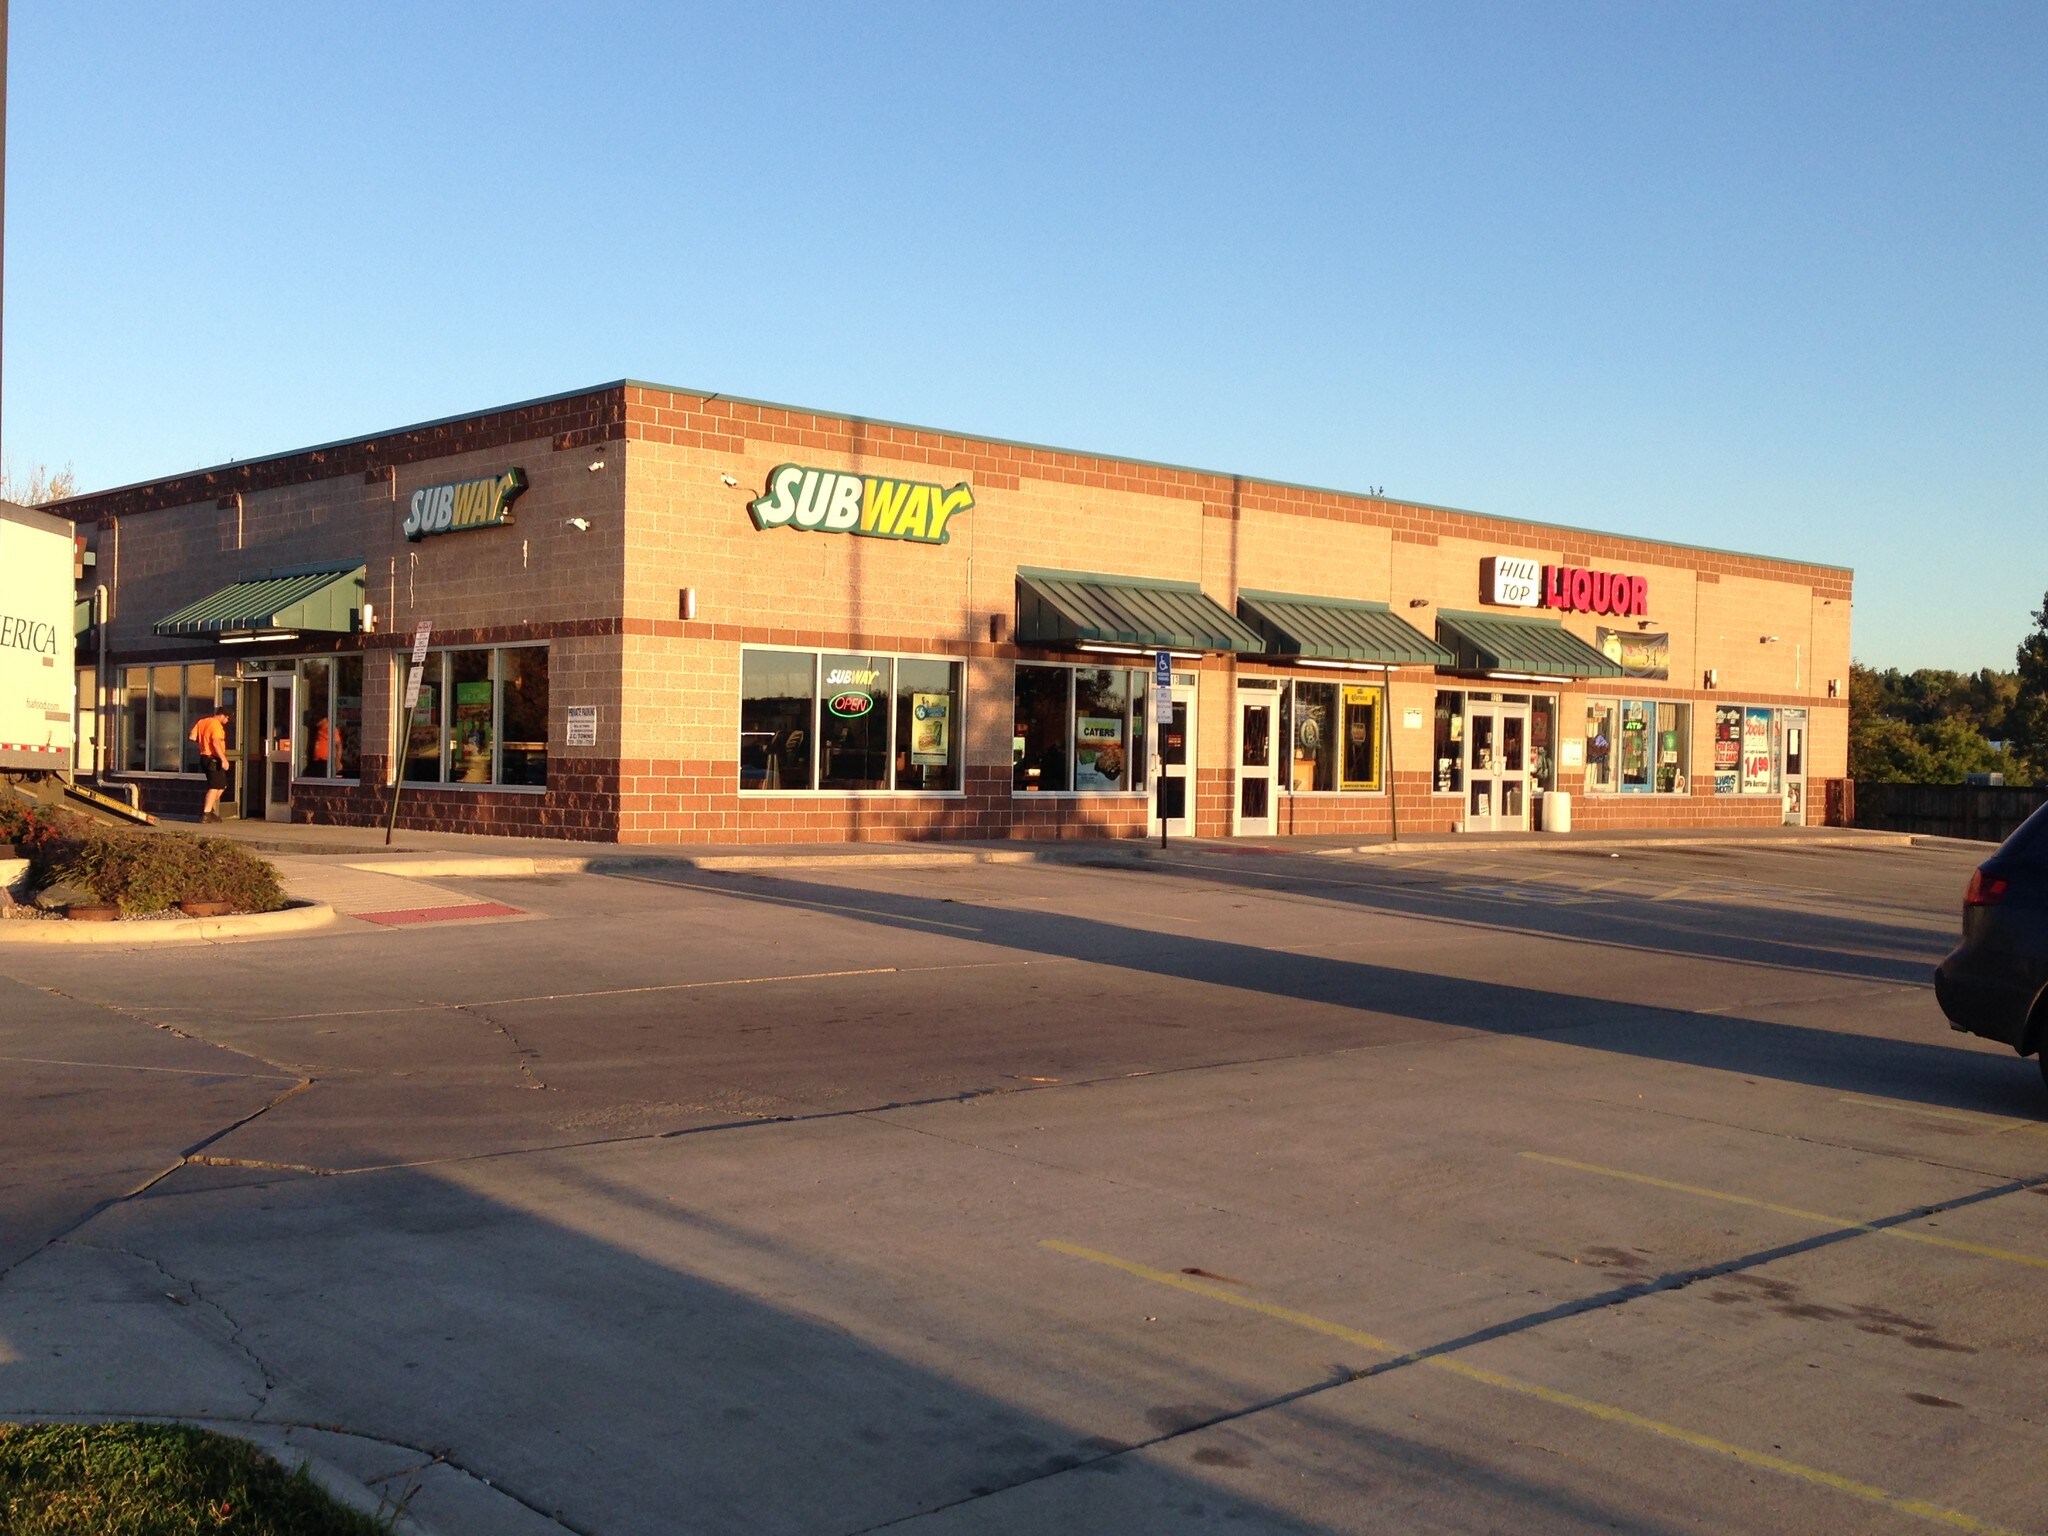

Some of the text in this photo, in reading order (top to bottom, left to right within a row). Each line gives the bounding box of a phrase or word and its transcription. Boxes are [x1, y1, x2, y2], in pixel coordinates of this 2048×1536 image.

[403, 473, 514, 536] SUBWAY
[755, 467, 973, 539] SUBWAY
[1499, 560, 1534, 581] HILL
[1502, 583, 1530, 601] TOP
[1545, 564, 1648, 616] LIQUOR
[0, 615, 56, 655] ERICA
[826, 668, 880, 685] SUBWAY
[834, 696, 868, 712] OPEN
[1083, 727, 1115, 738] CATERS
[1745, 719, 1766, 736] Coors
